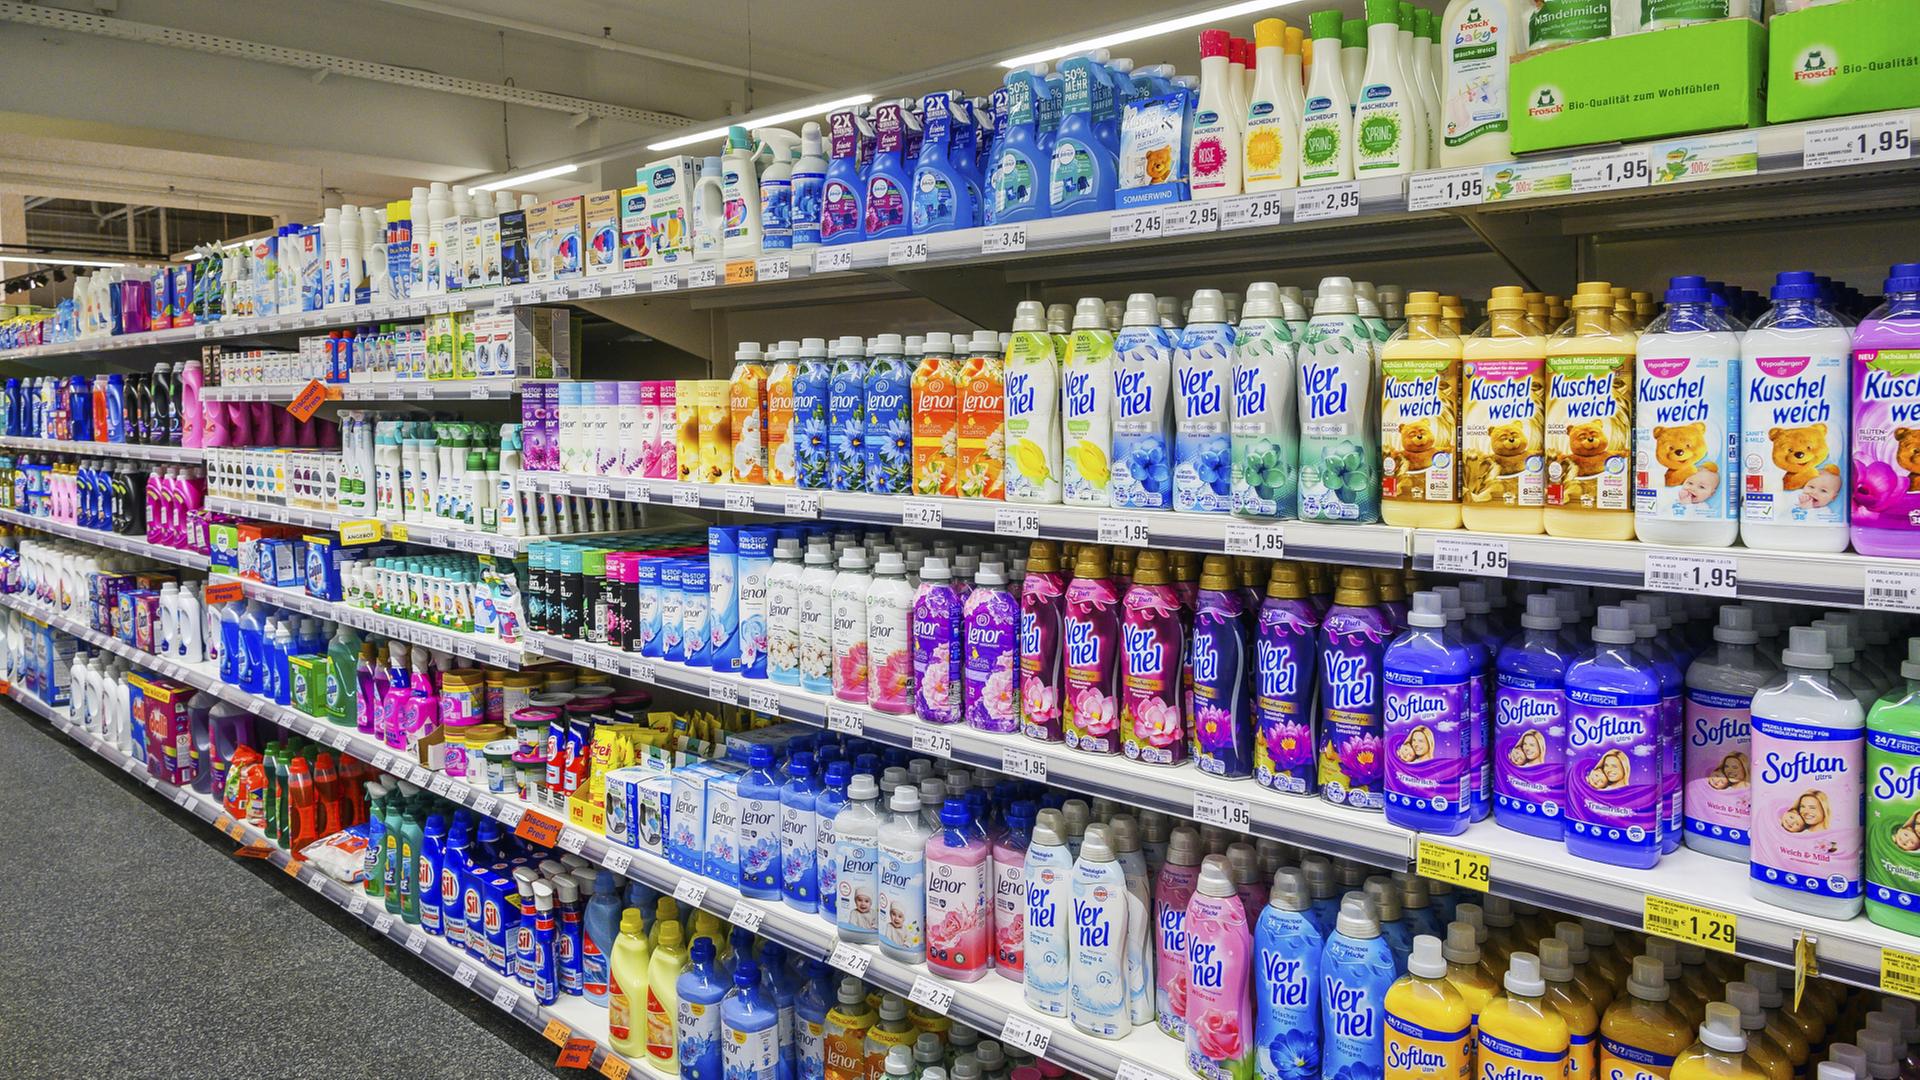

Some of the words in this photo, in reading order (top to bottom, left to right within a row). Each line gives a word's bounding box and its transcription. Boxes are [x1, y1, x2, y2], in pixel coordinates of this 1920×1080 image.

[1535, 4, 1607, 25] Mandelmilch
[1460, 20, 1489, 31] Frosch
[1456, 29, 1491, 44] baby
[1064, 66, 1087, 81] 50%
[1794, 66, 1838, 80] Frosch
[1843, 56, 1919, 76] Bio-Qualität
[1065, 78, 1088, 91] MEHR
[926, 95, 945, 110] 2X
[1568, 93, 1630, 111] Bio-Qualität
[1633, 90, 1655, 103] zum
[1658, 81, 1720, 99] Wohlfühlen
[879, 107, 897, 121] 2X
[1528, 105, 1563, 117] Frosch
[833, 115, 851, 128] 2X
[1365, 125, 1391, 142] SPRING
[1859, 129, 1909, 156] 1,95
[1308, 135, 1332, 152] SPRING
[1198, 148, 1215, 164] ROSE
[1605, 157, 1648, 183] 1,95
[1690, 161, 1710, 174] 100%
[1123, 190, 1173, 205] SOMMERWIND
[1447, 179, 1482, 200] 1,95
[1251, 200, 1280, 218] 2,95
[1326, 191, 1358, 211] 2,95
[1135, 215, 1161, 233] 2,45
[1190, 207, 1217, 225] 2,95
[1003, 232, 1025, 246] 3,45
[832, 253, 850, 265] 3,45
[907, 244, 926, 257] 3,45
[738, 267, 754, 280] 2,95
[773, 261, 789, 274] 3,95
[663, 274, 678, 286] 3,45
[1408, 361, 1445, 370] Mikroplastik
[1573, 356, 1619, 366] Mikroplastik
[1858, 353, 1874, 361] NEU
[1005, 371, 1028, 398] Ver
[1065, 370, 1089, 398] Ver
[1114, 368, 1145, 397] Ver
[1179, 367, 1213, 397] Ver
[1232, 364, 1260, 396] Ver
[1303, 363, 1339, 396] Ver
[1385, 376, 1439, 400] Kuschel
[1470, 376, 1531, 401] Kuschel
[1551, 373, 1613, 399] Kuschel
[1750, 375, 1826, 403] Kuschel
[291, 381, 320, 415] Discount-
[1639, 376, 1705, 403] Kuschel
[303, 396, 322, 414] Preis
[830, 394, 859, 412] Lenor
[867, 391, 903, 412] Lenor
[918, 391, 956, 412] Lenor
[962, 391, 1003, 412] Lenor
[1009, 387, 1034, 417] nel
[1069, 387, 1095, 418] nel
[1120, 386, 1151, 418] nel
[1187, 385, 1221, 418] nel
[1236, 383, 1266, 419] nel
[1311, 382, 1347, 419] nel
[1399, 398, 1441, 418] weich
[1489, 400, 1534, 420] weich
[1567, 397, 1616, 418] weich
[1657, 400, 1709, 423] weich
[1773, 400, 1830, 424] weich
[685, 493, 698, 503] 3,95
[739, 497, 754, 507] 2,75
[800, 500, 817, 512] 2,75
[921, 510, 941, 523] 2,75
[1017, 516, 1039, 530] 1,95
[347, 532, 374, 541] ANGEBOT
[1124, 526, 1149, 540] 1,95
[1256, 533, 1283, 550] 1,95
[1472, 551, 1508, 571] 1,95
[1692, 567, 1737, 589] 1,95
[769, 604, 792, 617] Lenor
[801, 611, 821, 624] Lenor
[833, 617, 856, 631] Lenor
[870, 624, 894, 639] Lenor
[1065, 617, 1092, 643] Ver
[1346, 620, 1361, 628] Duft
[968, 624, 1004, 644] Lenor
[1124, 623, 1155, 653] Ver
[1071, 638, 1098, 665] nel
[1131, 646, 1160, 675] nel
[1258, 640, 1289, 672] Ver
[1324, 651, 1364, 683] Ver
[1263, 665, 1296, 696] nel
[1399, 676, 1424, 685] FRISCHE
[722, 688, 737, 699] 6,95
[1335, 675, 1374, 708] nel
[1571, 689, 1590, 701] 24/7
[1590, 695, 1618, 706] FRISCHE
[764, 699, 779, 710] 2,65
[1385, 694, 1447, 723] Softlan
[1498, 698, 1558, 725] Softlan
[845, 716, 863, 729] 2,75
[1571, 716, 1644, 746] Softlan
[1692, 718, 1751, 747] Softla
[1875, 735, 1896, 748] 24/7
[931, 737, 950, 751] 2,75
[1024, 760, 1046, 775] 1,95
[1761, 752, 1848, 784] Softlan
[573, 805, 584, 817] rei
[676, 798, 698, 815] Lenor
[1222, 806, 1250, 825] 1,95
[1587, 801, 1629, 815] Traumfrisch
[524, 812, 560, 833] Discount-
[592, 814, 603, 825] rei
[712, 809, 736, 827] Lenor
[741, 810, 775, 826] Lenor
[782, 817, 807, 835] Lenor
[527, 826, 546, 841] Preis
[818, 827, 836, 846] Leno
[614, 857, 629, 870] 5,95
[1780, 846, 1802, 857] Weich
[1803, 850, 1809, 859] &
[1810, 852, 1830, 863] Mild
[843, 855, 878, 874] Lenor
[1454, 859, 1489, 882] 1,29
[881, 867, 910, 888] Lenor
[929, 878, 967, 896] Lenor
[688, 888, 704, 901] 2,75
[1025, 880, 1050, 908] Ver
[467, 896, 478, 917] Sil
[1030, 903, 1055, 928] nel
[1074, 900, 1102, 928] Ver
[485, 907, 498, 928] Sil
[745, 909, 762, 929] 2,75
[1080, 926, 1109, 948] nel
[1690, 915, 1735, 943] 1,29
[518, 932, 530, 950] Sil
[1187, 933, 1216, 965] Ver
[848, 952, 868, 971] 2,75
[1080, 951, 1096, 962] Derma
[1080, 958, 1092, 967] Care
[1193, 961, 1223, 989] nel
[1263, 951, 1301, 983] Ver
[929, 988, 951, 1009] 2,75
[1272, 978, 1307, 1006] nel
[1327, 978, 1365, 1012] Ver
[1336, 1008, 1373, 1037] nel
[1024, 1031, 1047, 1050] 1,95
[828, 1050, 859, 1069] Lenor
[1388, 1042, 1447, 1070] Softlan
